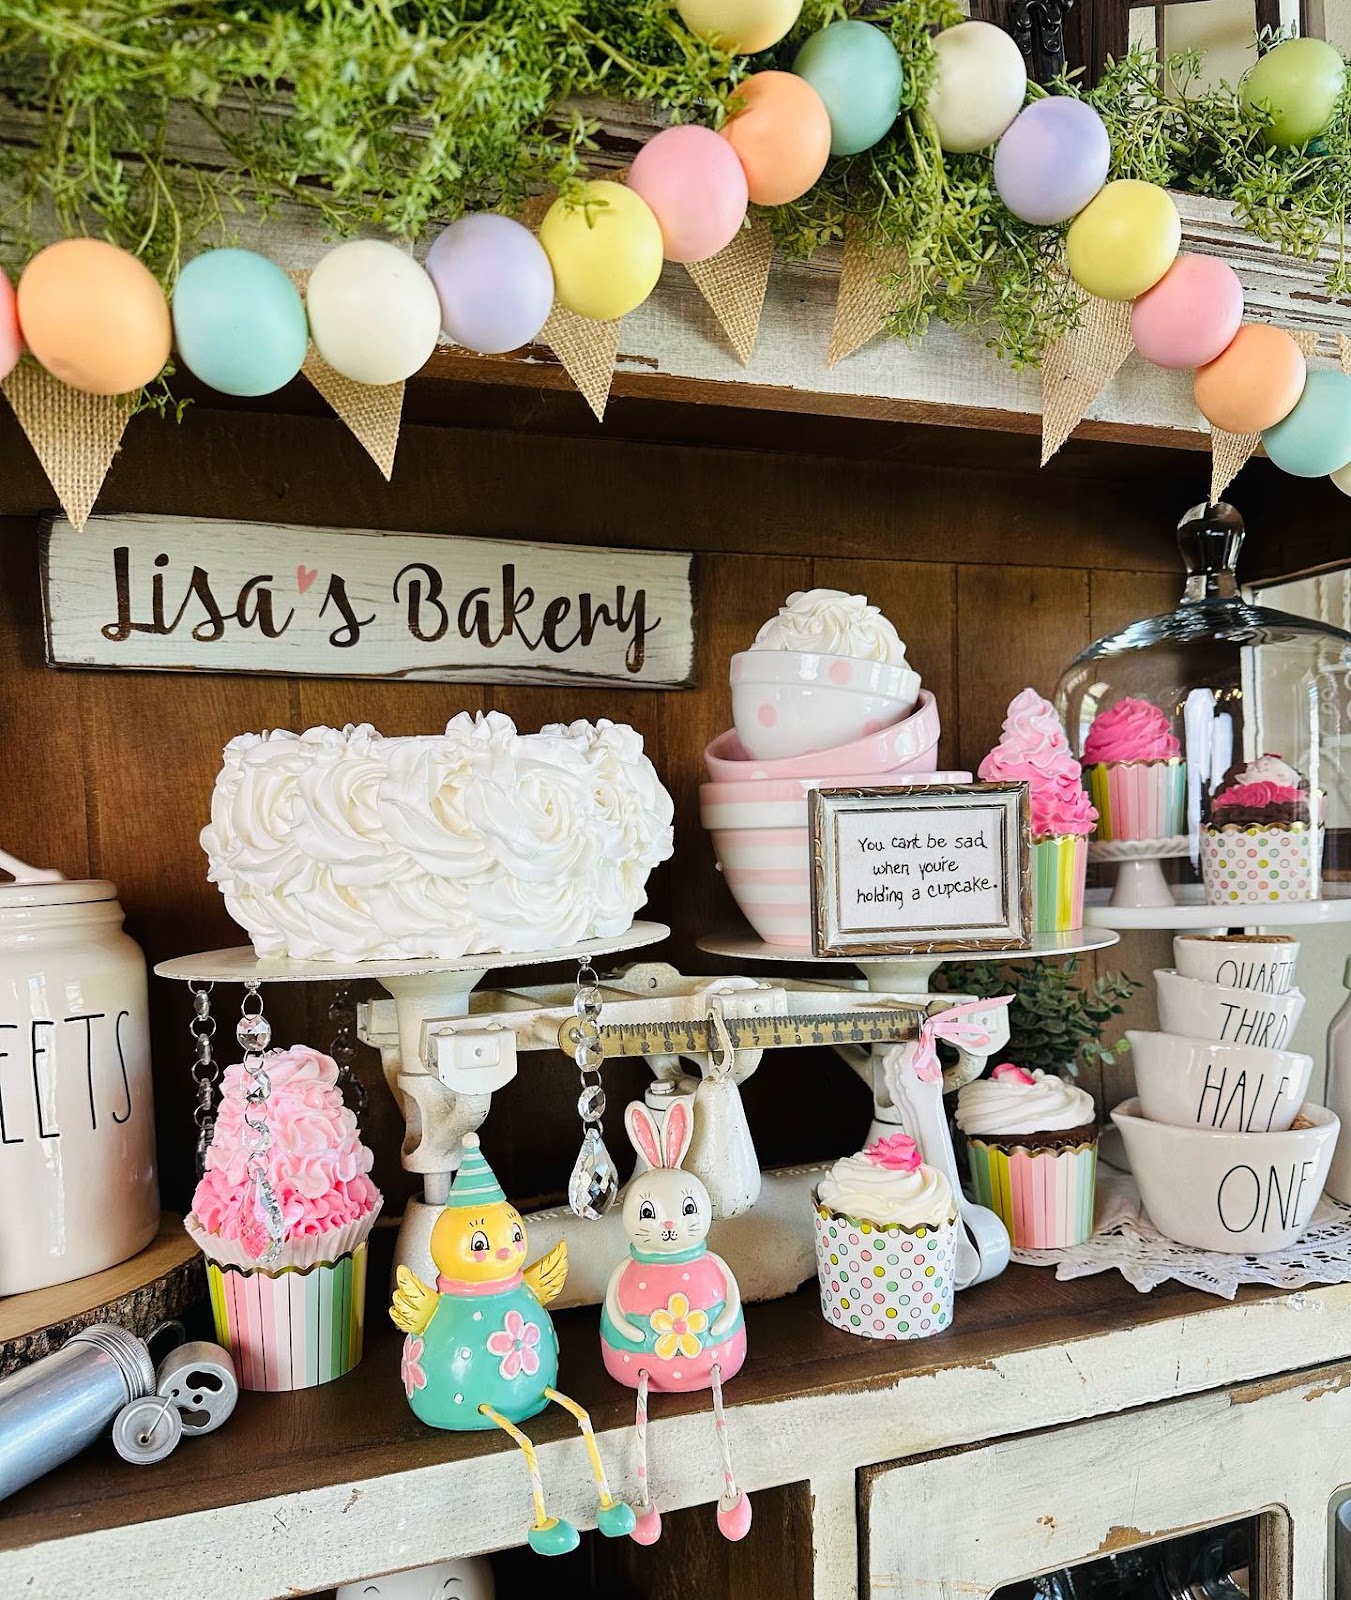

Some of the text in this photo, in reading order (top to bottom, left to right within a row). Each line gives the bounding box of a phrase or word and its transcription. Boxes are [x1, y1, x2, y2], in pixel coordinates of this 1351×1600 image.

[101, 546, 661, 673] Lisa's Bakery
[858, 837, 885, 852] You
[927, 833, 947, 849] be
[954, 830, 988, 849] sad
[872, 856, 959, 880] when you're
[856, 876, 998, 910] holding a cupcake.
[1220, 1002, 1289, 1050] THIRD
[1197, 1064, 1289, 1133] HALF
[1217, 1161, 1312, 1233] ONE
